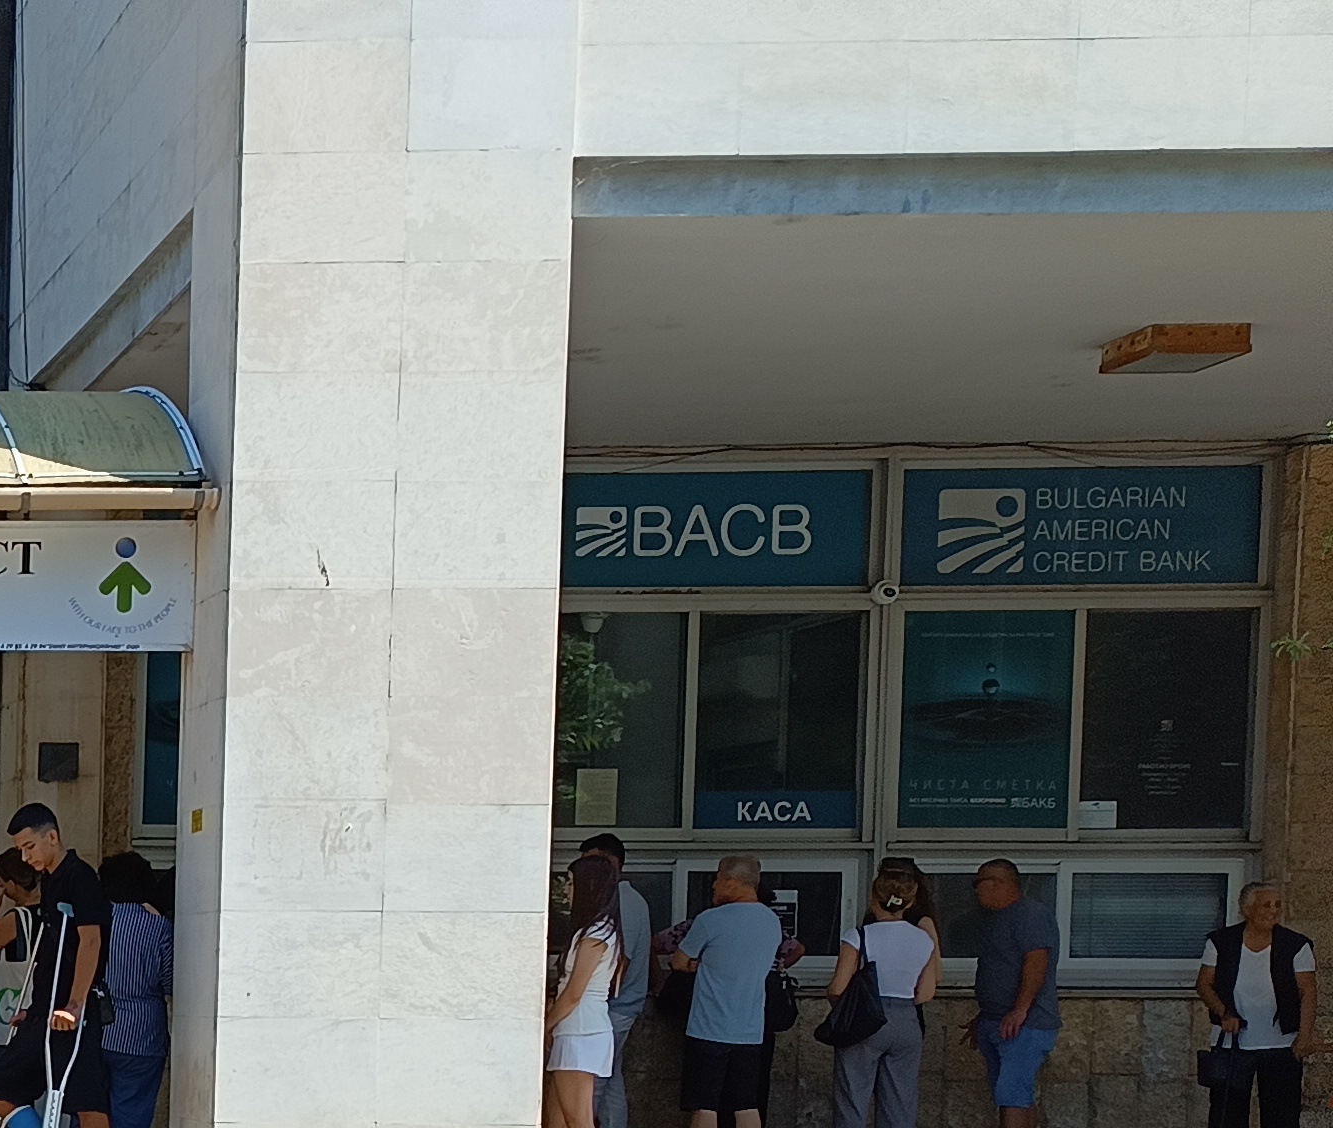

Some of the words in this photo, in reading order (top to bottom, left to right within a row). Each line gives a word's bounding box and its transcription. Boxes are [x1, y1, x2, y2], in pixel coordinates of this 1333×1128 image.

[1035, 486, 1187, 509] BULGARIAN
[633, 503, 812, 557] BACB
[1033, 518, 1171, 541] AMERICAN
[1033, 551, 1129, 573] CREDIT
[1139, 550, 1211, 573] BANK
[909, 778, 970, 791] ЧИСТА
[983, 778, 1057, 791] СМЕТКА
[737, 801, 812, 822] КАСА
[1021, 797, 1056, 809] БАКБ
